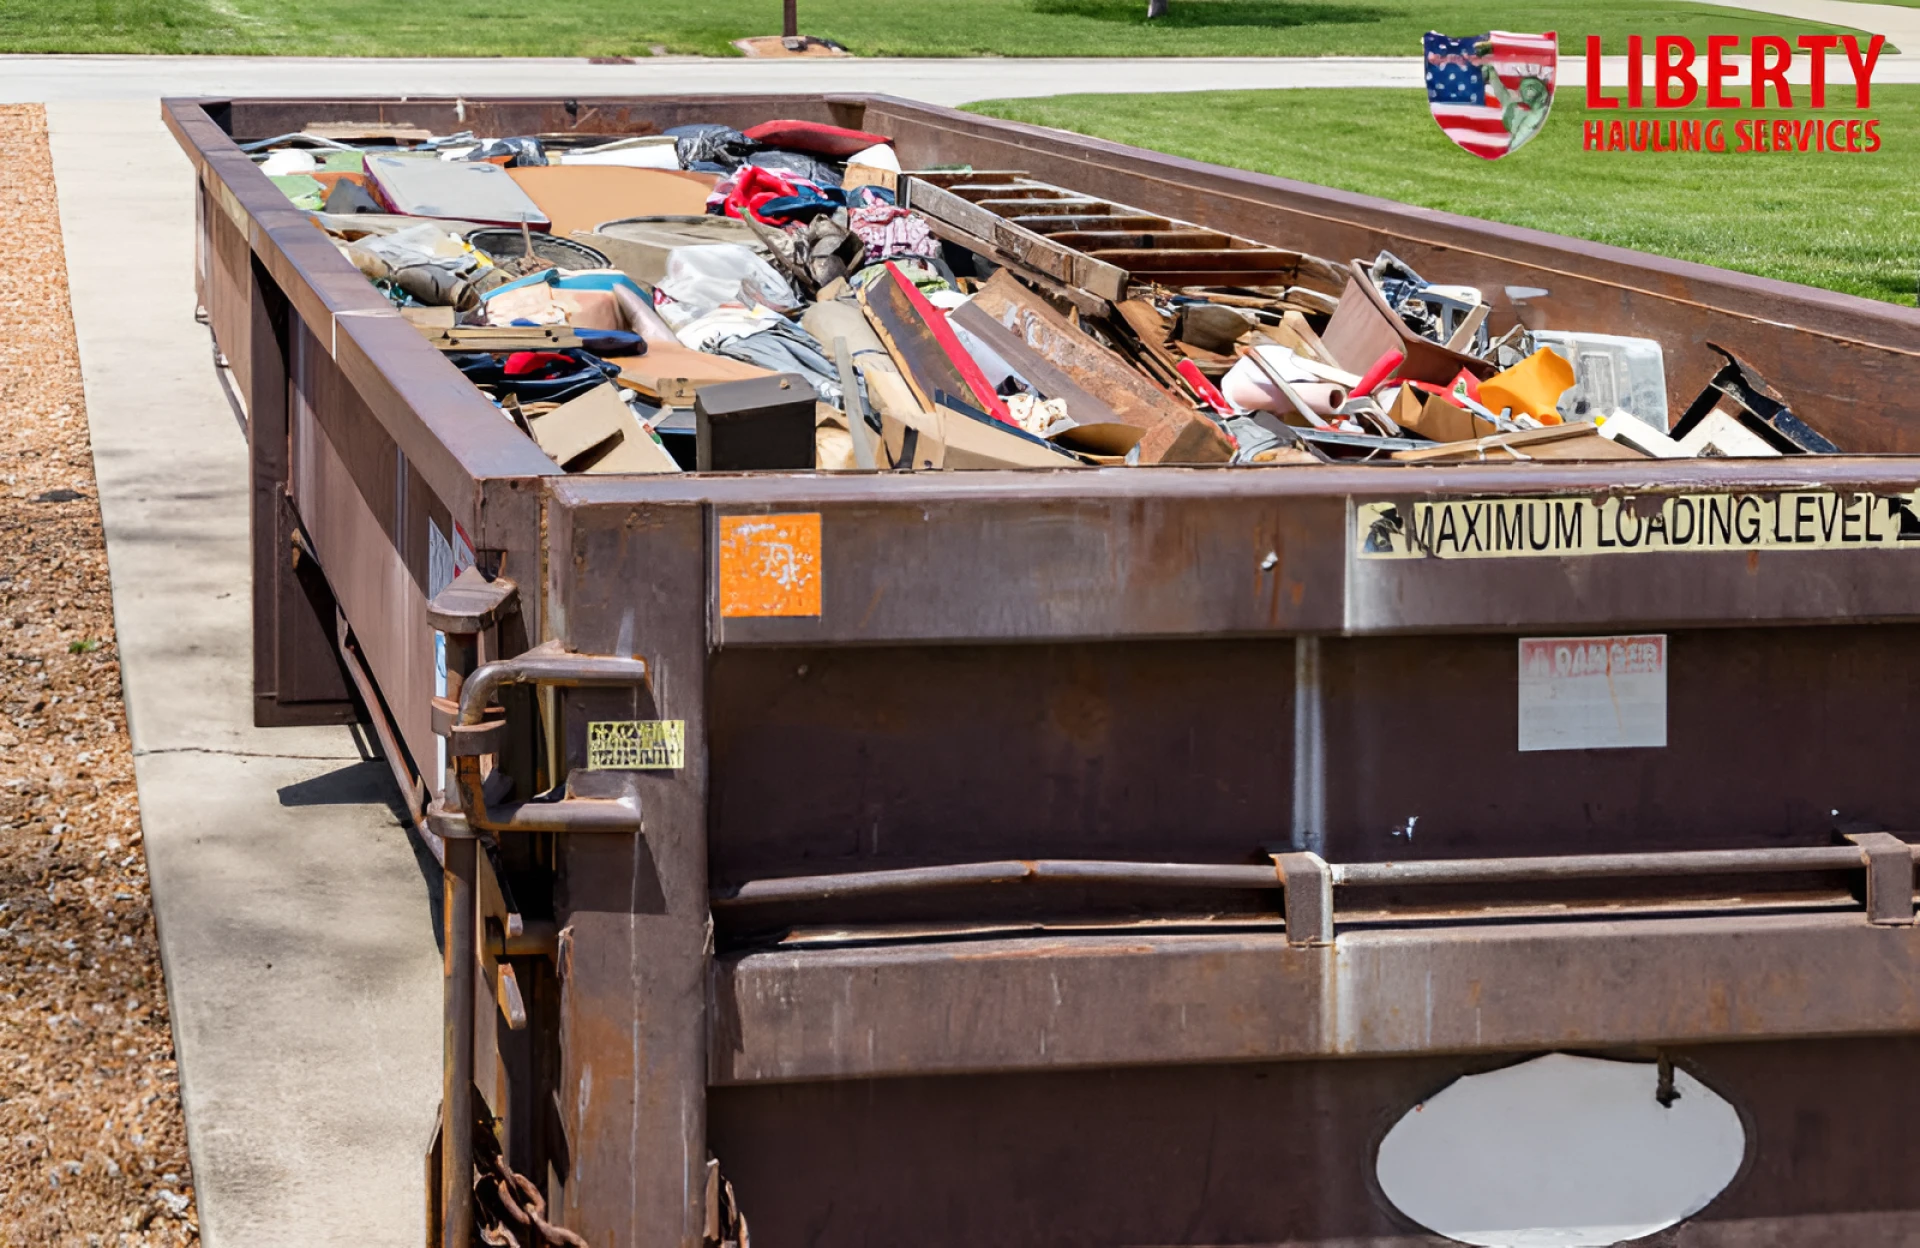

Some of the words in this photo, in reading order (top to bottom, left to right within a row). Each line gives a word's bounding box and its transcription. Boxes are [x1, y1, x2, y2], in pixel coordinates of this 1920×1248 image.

[1409, 502, 1583, 554] MAXIMUM
[1597, 496, 1760, 547] LOADING
[1775, 495, 1883, 542] LEVEL
